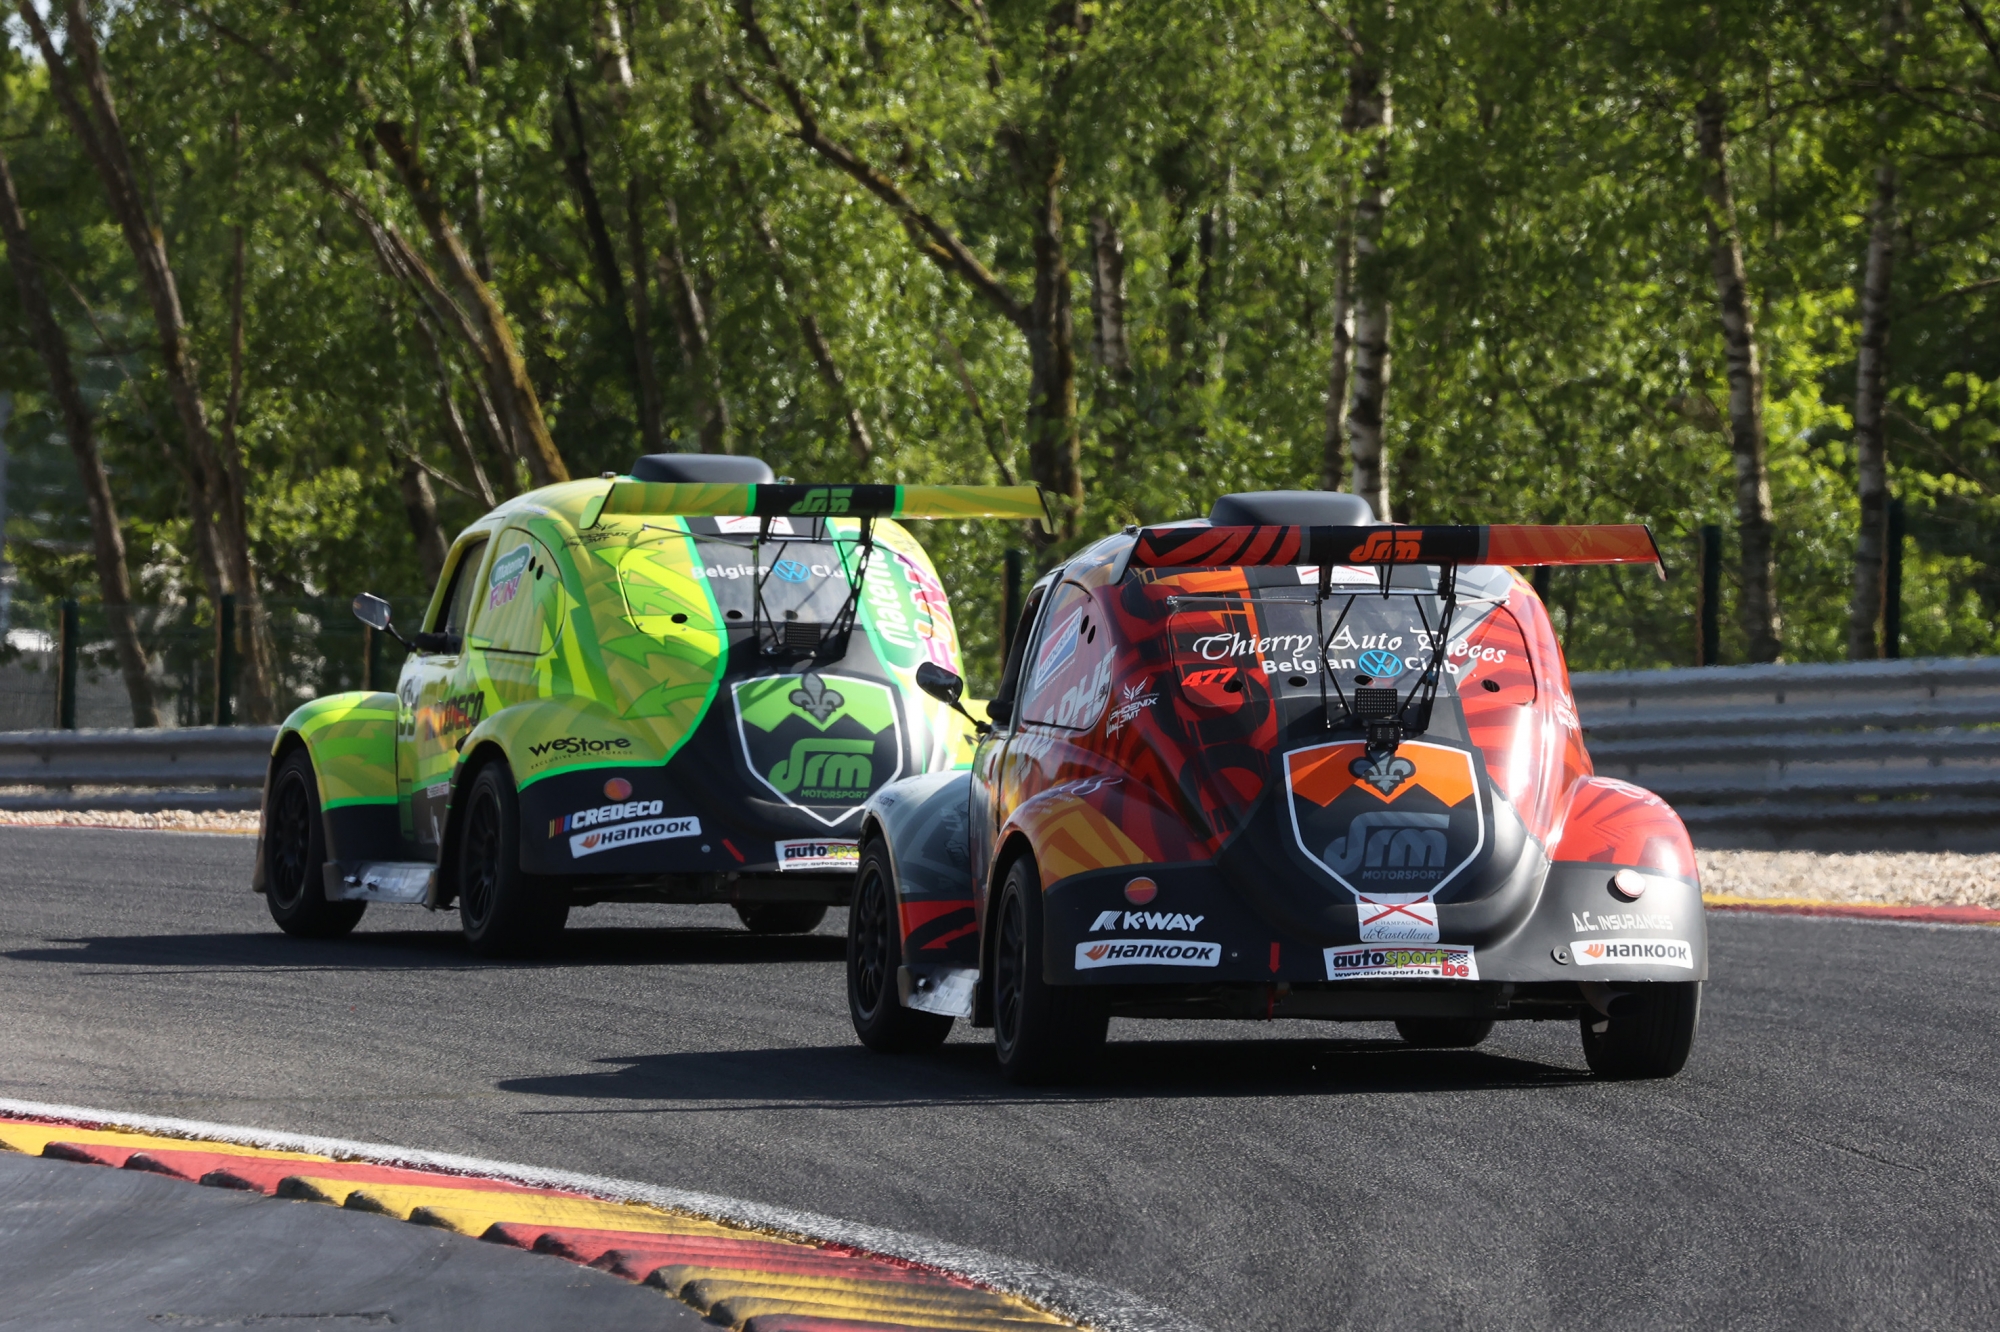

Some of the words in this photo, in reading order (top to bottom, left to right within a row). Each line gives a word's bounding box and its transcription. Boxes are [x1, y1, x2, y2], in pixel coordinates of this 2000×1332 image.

[690, 564, 773, 580] Belgian
[1193, 631, 1313, 661] Thierry
[1328, 625, 1403, 651] Auto
[1181, 667, 1238, 687] 477
[531, 754, 572, 770] EXCLUSIVE
[801, 789, 868, 799] MOTORSPORT
[571, 800, 663, 829] CREDECO
[784, 843, 860, 860] autospo
[1362, 870, 1444, 881] MOTORSPORT
[1572, 911, 1599, 932] A.C.
[1597, 914, 1673, 931] INSURANCES
[1363, 928, 1376, 940] de
[1374, 926, 1434, 940] Castellane
[1334, 968, 1430, 978] www.autosport.be
